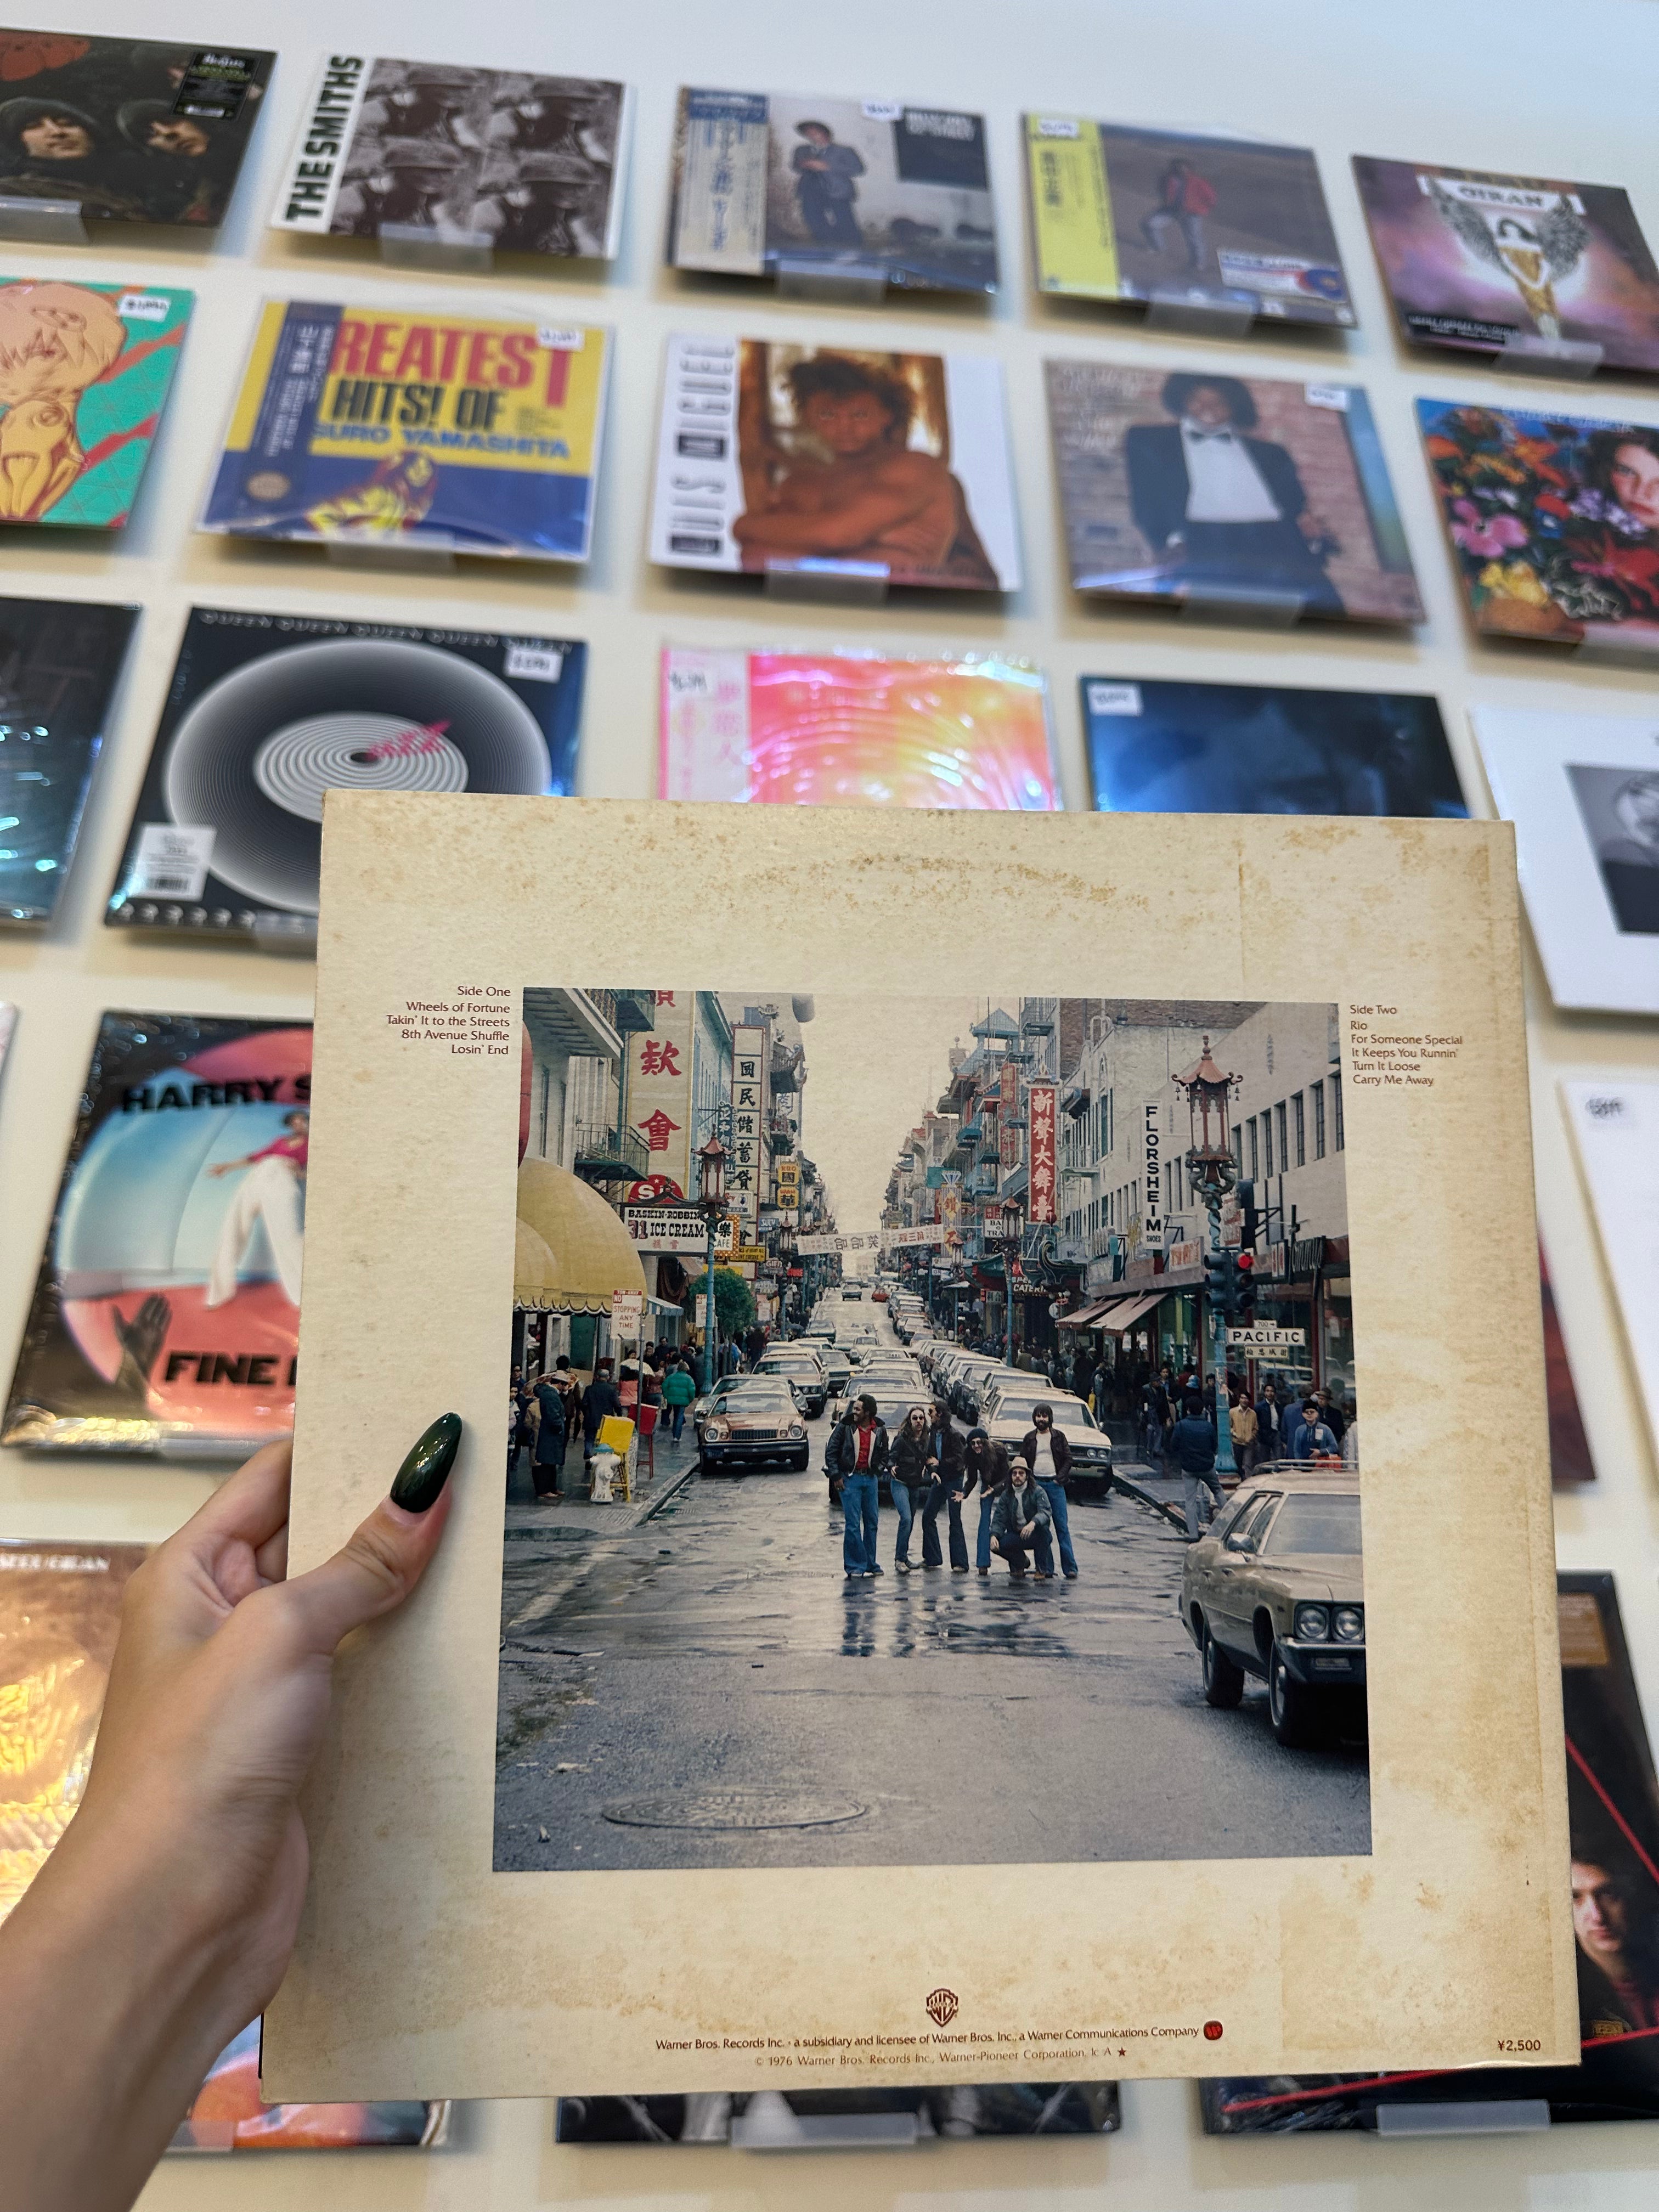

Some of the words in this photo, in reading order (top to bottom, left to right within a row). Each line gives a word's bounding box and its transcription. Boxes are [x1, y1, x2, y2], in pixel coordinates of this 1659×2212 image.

[305, 56, 365, 157] SMITHS
[285, 161, 336, 221] THE
[330, 320, 573, 408] REATEST
[332, 380, 444, 429] HITS!
[455, 387, 508, 431] OF
[403, 428, 569, 458] YAMASHITA
[458, 986, 483, 996] Side
[486, 986, 511, 996] One
[407, 1001, 449, 1012] Wheels
[452, 1003, 465, 1012] of
[467, 1003, 510, 1013] Fortune
[1350, 1005, 1373, 1014] Side
[1376, 1005, 1397, 1014] Two
[421, 1015, 429, 1025] It
[433, 1017, 445, 1026] to
[449, 1016, 467, 1026] the
[470, 1017, 510, 1027] Streets
[1350, 1020, 1368, 1030] Rio
[402, 1029, 421, 1039] 8th
[424, 1030, 468, 1040] Avenue
[471, 1030, 510, 1041] Shuffle
[1351, 1034, 1368, 1043] For
[1370, 1034, 1422, 1045] Someone
[1425, 1035, 1463, 1047] Special
[488, 1045, 509, 1054] End
[1352, 1047, 1359, 1057] It
[1362, 1047, 1396, 1059] Keeps
[1397, 1048, 1417, 1058] You
[1352, 1061, 1374, 1070] Turn
[1378, 1062, 1385, 1070] It
[1389, 1062, 1421, 1071] Loose
[1353, 1074, 1381, 1087] Carry
[1384, 1075, 1402, 1085] Me
[1406, 1075, 1434, 1087] Away
[121, 1074, 281, 1114] HARRY
[1146, 1106, 1161, 1232] FLORSHEIM
[629, 1209, 700, 1220] BASKIN-ROBBIN
[628, 1220, 648, 1239] 31
[650, 1222, 666, 1237] ICE
[669, 1223, 704, 1238] CREAM
[613, 1305, 640, 1313] STOPPING
[1233, 1331, 1300, 1342] PACIFIC
[164, 1350, 276, 1386] FINE
[656, 2039, 692, 2050] Warner
[695, 2038, 720, 2049] Bros.
[723, 2038, 765, 2049] Records
[768, 2037, 785, 2048] Inc.
[794, 2039, 800, 2047] a
[803, 2036, 852, 2049] subsidiary
[854, 2034, 873, 2046] and
[877, 2034, 917, 2045] licensee
[919, 2033, 930, 2044] of
[932, 2032, 968, 2043] Warner
[970, 2032, 995, 2042] Bros.
[1019, 2033, 1025, 2041] a
[1028, 2030, 1063, 2040] Warner
[1065, 2028, 1149, 2040] Communications
[1151, 2026, 1199, 2038] Company
[1497, 2039, 1541, 2052] ¥2,500
[769, 2056, 793, 2066] 1976
[798, 2055, 836, 2066] Warner
[840, 2055, 865, 2066] Bros.
[870, 2053, 910, 2064] Records
[939, 2051, 1019, 2063] Warner-Pioneer
